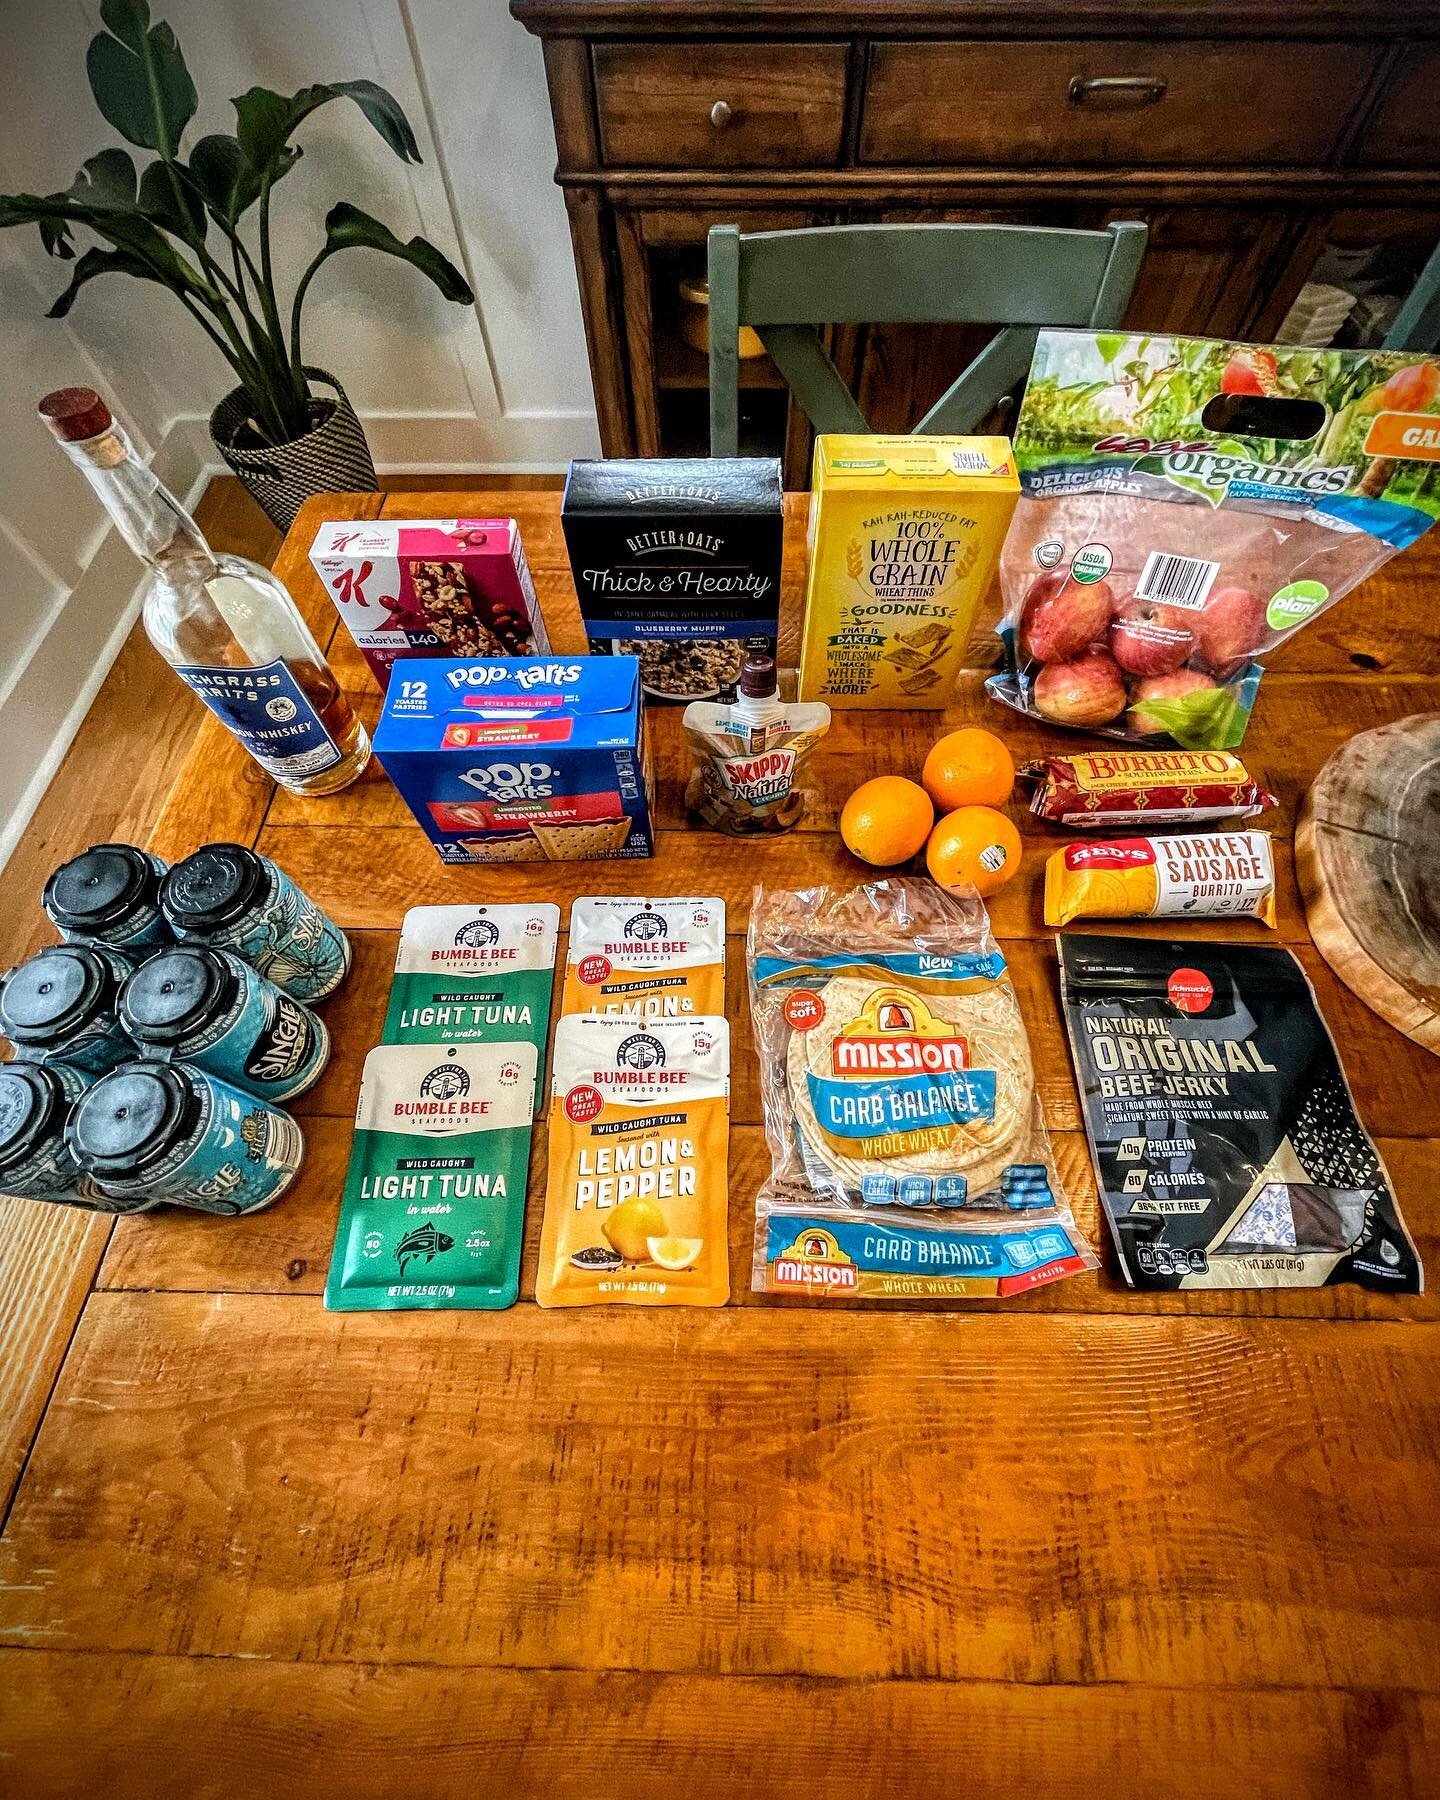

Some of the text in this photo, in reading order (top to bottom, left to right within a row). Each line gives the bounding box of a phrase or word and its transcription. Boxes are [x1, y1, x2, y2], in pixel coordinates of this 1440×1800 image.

[1031, 467, 1124, 489] DELICIOUS
[1168, 451, 1349, 493] organics
[626, 486, 720, 501] BETTER OATS
[1036, 480, 1142, 497] ORGANIC APPLES
[863, 510, 977, 529] RAH RAH-REDUCED FAT
[897, 522, 945, 539] 100%
[626, 531, 721, 551] BETTER OATS
[870, 540, 960, 563] WHOLE
[1083, 553, 1105, 564] USDA
[869, 564, 948, 585] GRAIN
[1075, 565, 1103, 575] ORGANIC
[332, 560, 374, 608] K
[583, 569, 771, 598] Thick & Hearty
[875, 587, 935, 597] WHEAT THINS
[851, 604, 949, 618] GOODNESS
[358, 634, 438, 646] calories 140
[837, 636, 878, 644] BAKED
[827, 650, 883, 662] WHOLESOME
[827, 668, 875, 678] WHERE
[400, 682, 428, 698] 12
[830, 685, 868, 695] MORE
[256, 721, 313, 739] WHISKEY
[725, 727, 748, 737] PRODUCT
[477, 733, 541, 742] STRAWBERRY
[725, 754, 790, 784] SKIPPY
[1083, 754, 1229, 779] BURRITO
[1124, 770, 1202, 779] SOUTHWESTERN
[487, 782, 553, 803] tarts
[734, 774, 795, 800] Natural
[494, 809, 577, 821] STRAWBERRY
[434, 843, 460, 854] 12
[1158, 836, 1255, 859] TURKEY
[1166, 857, 1264, 883] SAUSAGE
[1193, 884, 1243, 897] BURRITO
[693, 914, 708, 923] 15g
[526, 924, 543, 932] 16g
[604, 942, 687, 954] BUMBLE BEE
[431, 949, 517, 961] BUMBLE BEE
[584, 960, 604, 969] NEW
[919, 956, 953, 970] New
[628, 981, 660, 991] CAUGHT
[791, 1000, 814, 1009] super
[400, 1005, 532, 1028] LIGHT TUNA
[789, 1006, 817, 1019] soft
[1085, 1017, 1170, 1035] NATURAL
[441, 1028, 483, 1038] in water
[249, 1000, 300, 1080] SINGLE
[694, 1038, 711, 1049] 15g
[838, 1041, 963, 1069] MISSION
[1091, 1036, 1277, 1073] ORIGINAL
[500, 1069, 519, 1079] 16g
[593, 1072, 687, 1084] BUMBLE BEE
[1101, 1076, 1230, 1098] BEEF JERKY
[572, 1091, 594, 1102] NEW
[394, 1102, 489, 1116] BUMBLE BEE
[572, 1101, 596, 1111] GREAT
[831, 1083, 980, 1125] CARB BALANCE
[1105, 1100, 1212, 1111] MADE FROM WHOLE MUSCLE BEEF
[571, 1108, 598, 1119] TASTE!
[1107, 1111, 1269, 1123] SIGNATURE SWEET TASTE WITH A HINT OF GARLIC
[597, 1116, 681, 1134] WILD CAUGHT TUNA
[861, 1129, 951, 1156] WHOLE WHEAT
[1122, 1139, 1196, 1155] 10g PROTEIN
[406, 1160, 428, 1168] WILD
[907, 1181, 924, 1190] HIGH
[1128, 1173, 1205, 1186] 80 CALORIES
[361, 1175, 507, 1199] LIGHT TUNA
[575, 1166, 697, 1210] PEPPER
[905, 1190, 925, 1200] FIBER
[407, 1204, 452, 1215] in water
[1160, 1203, 1174, 1212] FAT
[1180, 1202, 1201, 1211] FREE
[864, 1237, 912, 1261] CARB
[918, 1240, 994, 1265] BALANCE
[1261, 1260, 1275, 1269] 2.85
[1276, 1260, 1285, 1269] OZ
[777, 1261, 854, 1286] MISSION
[1037, 1266, 1065, 1280] FAJITA
[388, 1286, 456, 1297] NET WT 2.5 OZ (71g)
[883, 1280, 967, 1294] WHOLE WHEAT
